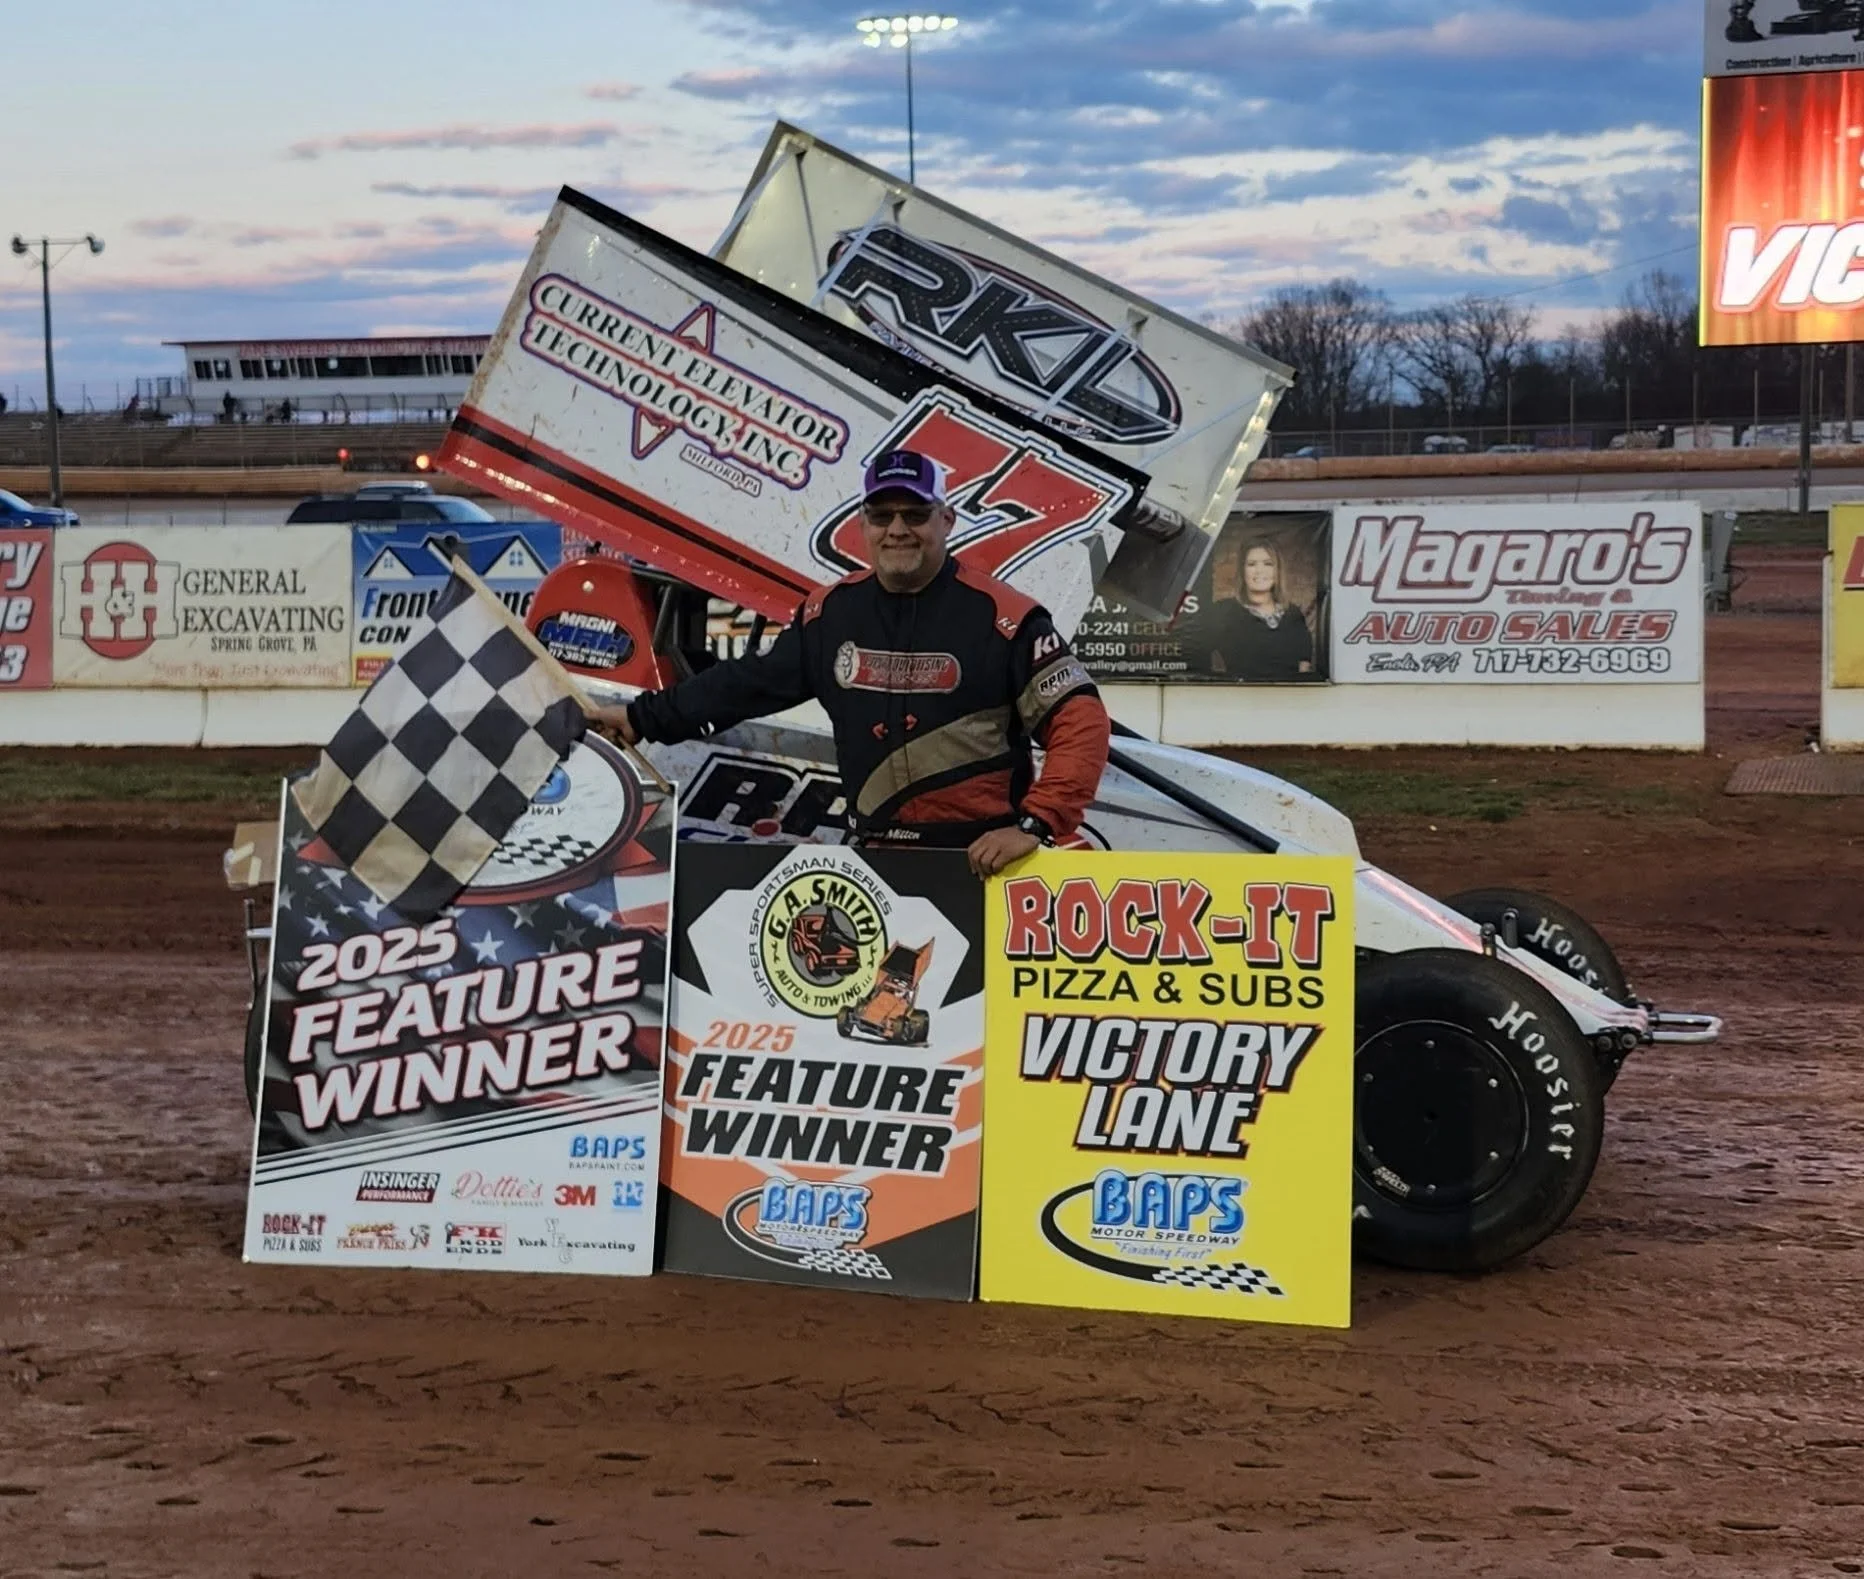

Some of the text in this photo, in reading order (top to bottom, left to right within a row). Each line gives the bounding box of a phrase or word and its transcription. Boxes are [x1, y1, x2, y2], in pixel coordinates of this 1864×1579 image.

[540, 282, 684, 370] CURRENT
[683, 353, 840, 451] ELEVATOR
[531, 319, 801, 481] TECHNOLOGY, INC.
[1339, 511, 1692, 604] Magaro's
[182, 568, 307, 597] GENERAL
[183, 605, 345, 633] EXCAVATING
[359, 625, 412, 644] CON
[1344, 611, 1678, 645] AUTO SALES
[210, 636, 318, 653] SPRING GROVE, PA
[1130, 643, 1182, 657] OFFICE
[1421, 652, 1462, 673] PA
[1472, 647, 1671, 674] 717-732-6969
[750, 856, 893, 937] SPORTSMAN SERIES
[809, 878, 879, 938] SMITH
[1004, 876, 1336, 970] ROCK-IT
[297, 918, 458, 993] 2025
[749, 942, 778, 1009] SUPER
[289, 939, 645, 1063] FEATURE
[776, 968, 805, 998] AUTO
[812, 983, 862, 1009] TOWING
[1013, 966, 1325, 1010] PIZZA & SUBS
[701, 1019, 798, 1053] 2025
[1020, 1013, 1324, 1093] VICTORY
[292, 1012, 635, 1131] WINNER
[680, 1052, 966, 1116] FEATURE
[1487, 1000, 1582, 1161] Hoosier
[685, 1106, 955, 1174] WINNER
[1074, 1084, 1262, 1158] LANE
[569, 1135, 646, 1160] BAPS
[361, 1171, 439, 1190] INSINGER
[452, 1170, 544, 1200] Dottie's
[554, 1184, 597, 1207] 3M
[760, 1180, 869, 1230] BAPS
[1091, 1169, 1245, 1235] BAPS
[262, 1214, 327, 1235] ROCK-IT
[262, 1238, 286, 1251] PIZZA
[299, 1239, 322, 1252] SUBS
[517, 1236, 548, 1248] York
[1091, 1227, 1241, 1246] MOTOR SPEEDWAY
